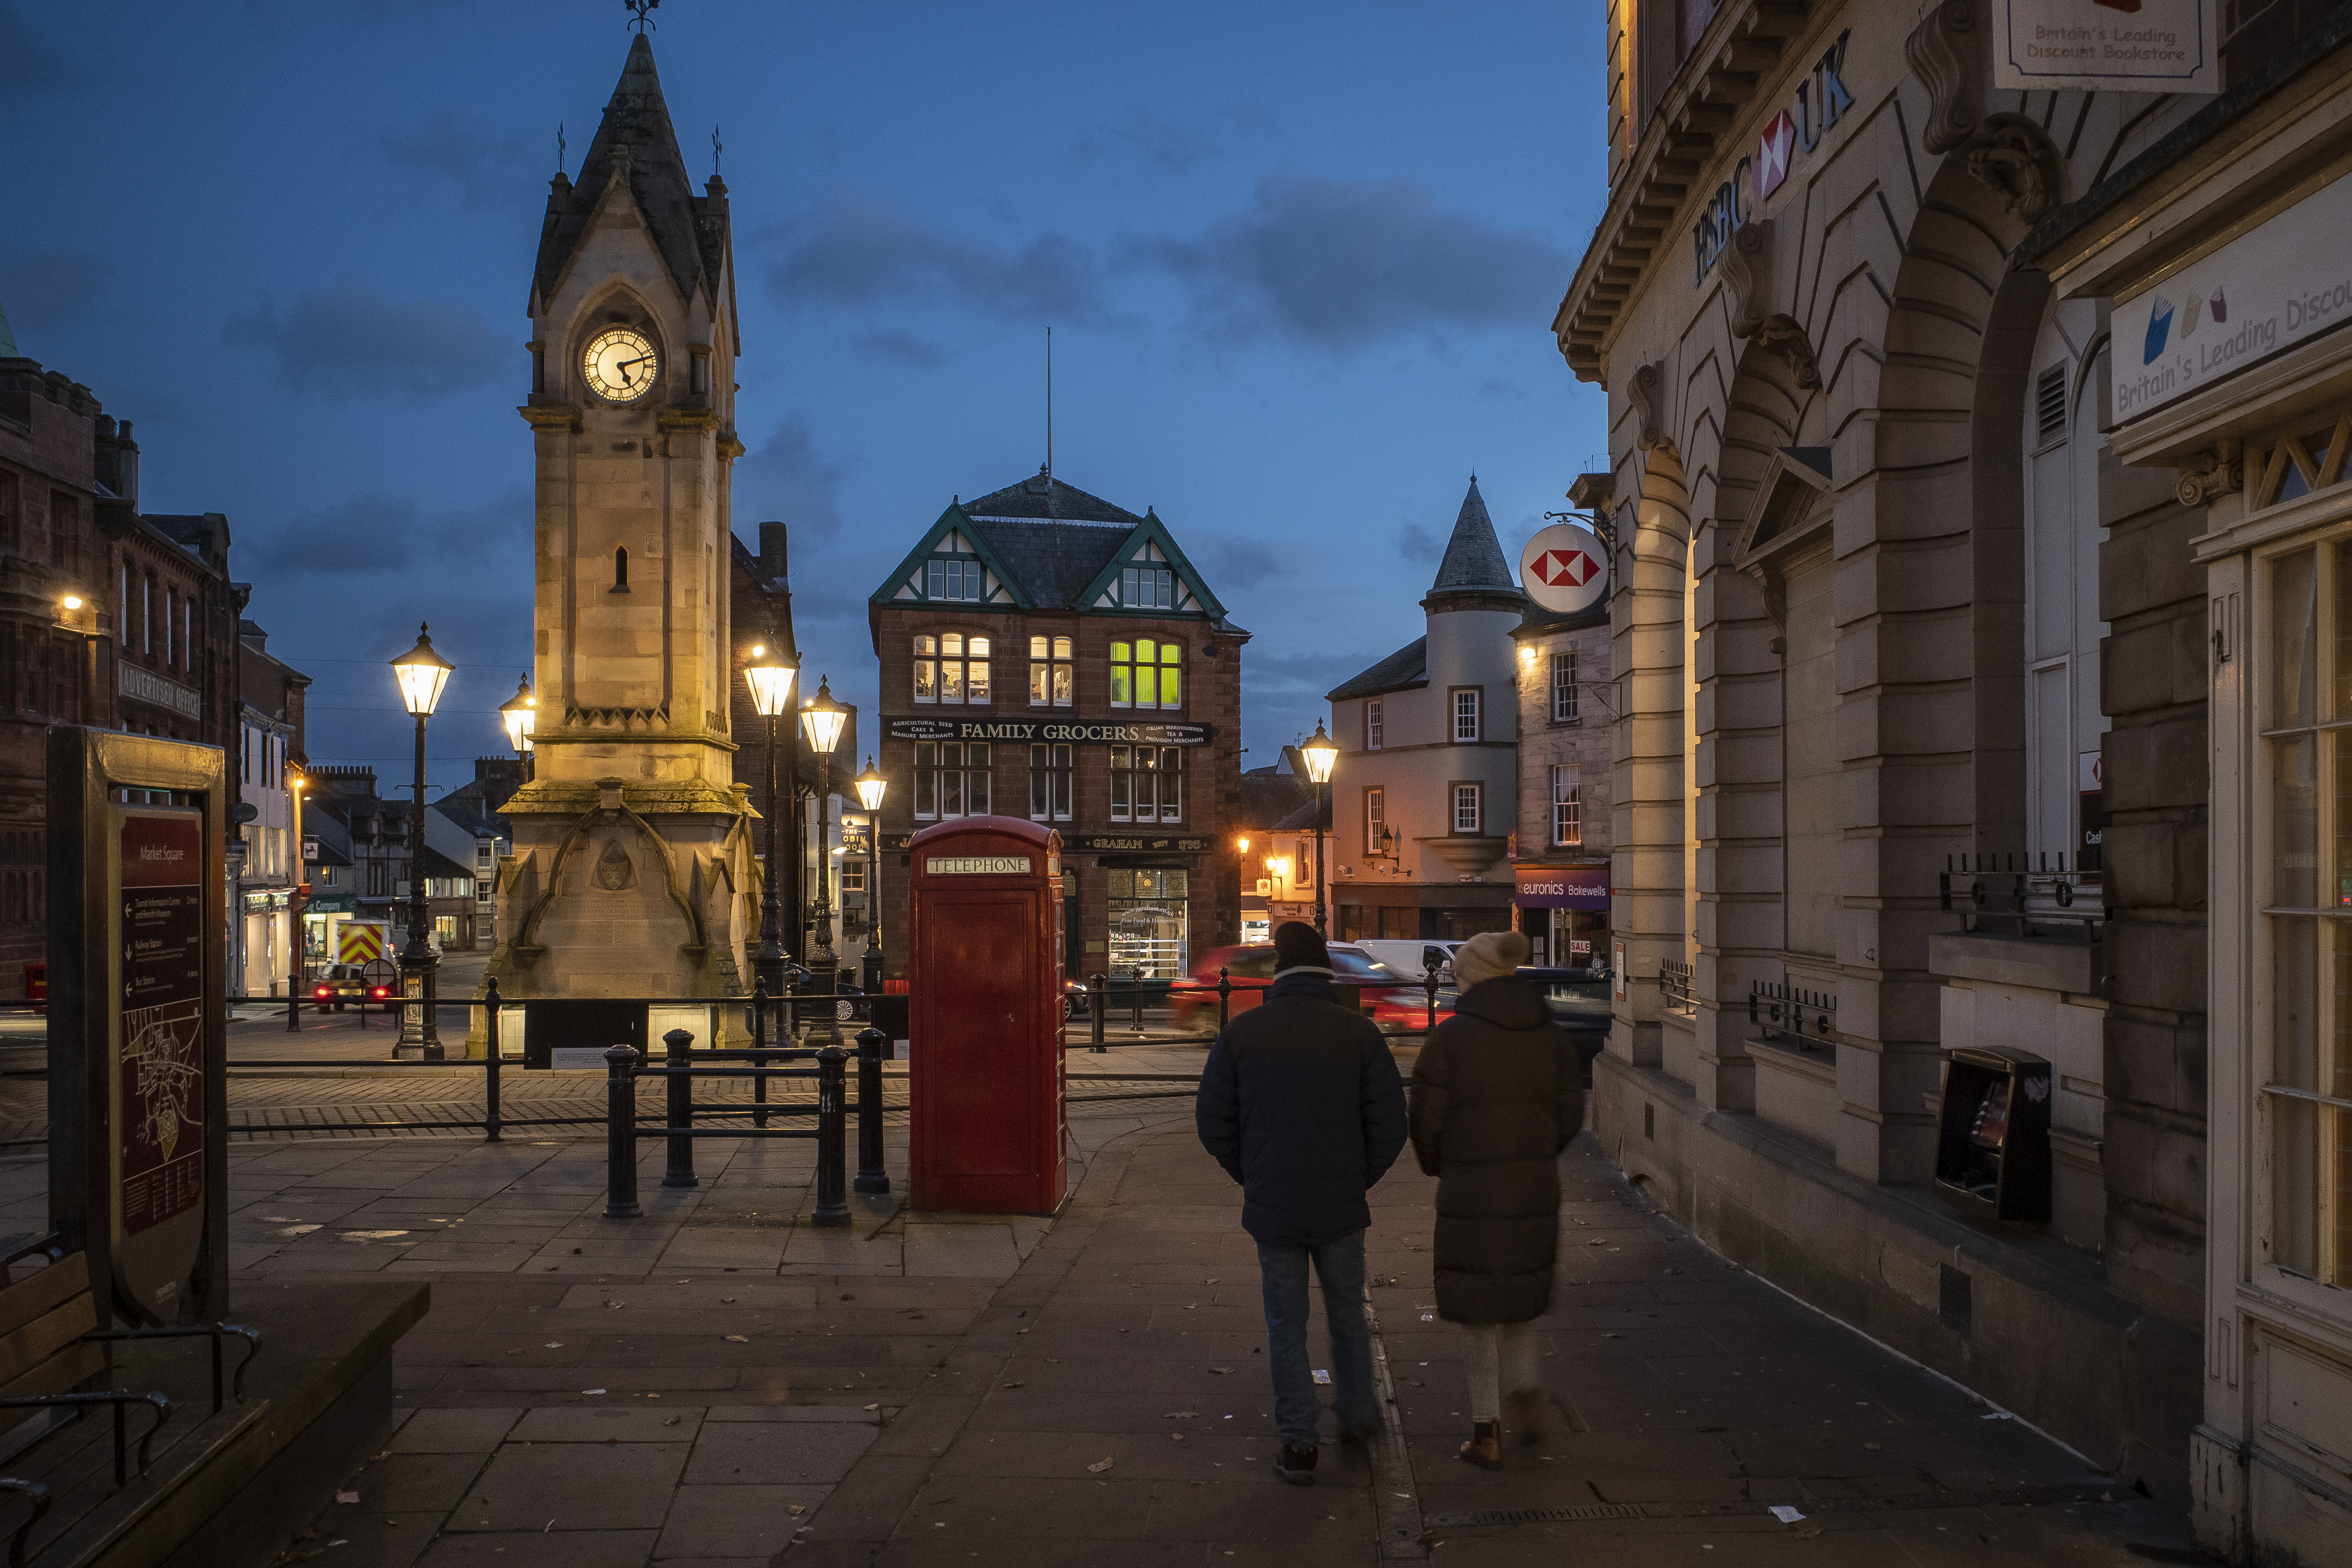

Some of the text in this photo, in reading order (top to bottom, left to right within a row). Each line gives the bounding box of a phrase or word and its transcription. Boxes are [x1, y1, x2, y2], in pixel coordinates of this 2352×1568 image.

[2035, 25, 2176, 46] Britain's Leading
[2027, 44, 2185, 61] Discount Bookstore
[1693, 27, 1855, 290] HSBC UK
[2119, 354, 2192, 412] Britain's
[2201, 317, 2276, 373] Leading
[124, 668, 200, 716] ADVERTISER OFFICE
[960, 724, 1139, 741] FAMILY GROCERS
[1093, 839, 1143, 849] GRAHAM
[1179, 840, 1201, 851] 1793
[140, 844, 184, 865] Market Square
[931, 858, 1026, 872] TELEPHONE
[1523, 880, 1606, 896] euronics Bakewells
[316, 900, 341, 912] Company
[1122, 905, 1174, 917] www.jjgraham.co.uk
[1571, 941, 1590, 951] SALE
